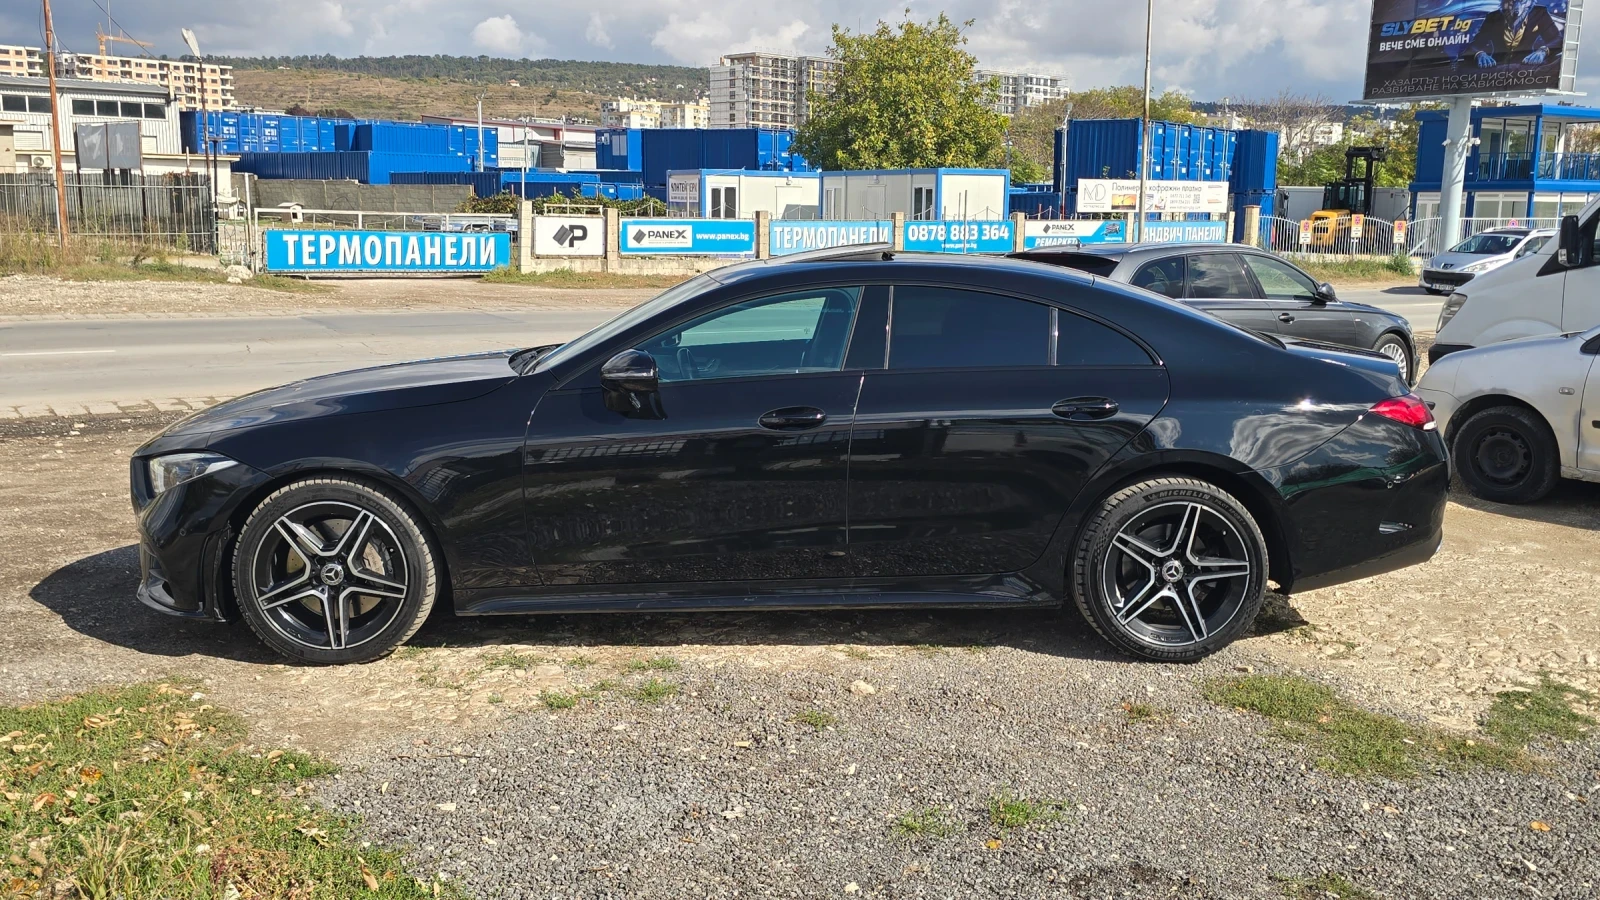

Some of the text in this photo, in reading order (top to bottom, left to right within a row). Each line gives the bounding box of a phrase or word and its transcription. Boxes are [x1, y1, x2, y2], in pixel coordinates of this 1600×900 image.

[1381, 16, 1472, 37] SLYBET.bg
[1379, 33, 1470, 51] ВЕЧЕ СМЕ ОНЛАЙН
[1371, 75, 1552, 95] РАЗВИВАНЕ НА ЗАВИСИМОСТ
[1383, 69, 1534, 87] ХАЗАРТЪТ НОСИ РИСК ОТ
[568, 224, 588, 248] P
[647, 229, 750, 241] PANEX www.panex.bg
[908, 224, 1010, 241] 0878 883 364
[1051, 223, 1075, 231] PANEX
[1143, 226, 1222, 243] АНДВИЧ ПАНЕЛИ
[774, 226, 889, 249] ТЕРМОПАНЕЛИ
[282, 234, 495, 266] ТЕРМОПАНЕЛИ
[1160, 489, 1211, 500] MICHELIN
